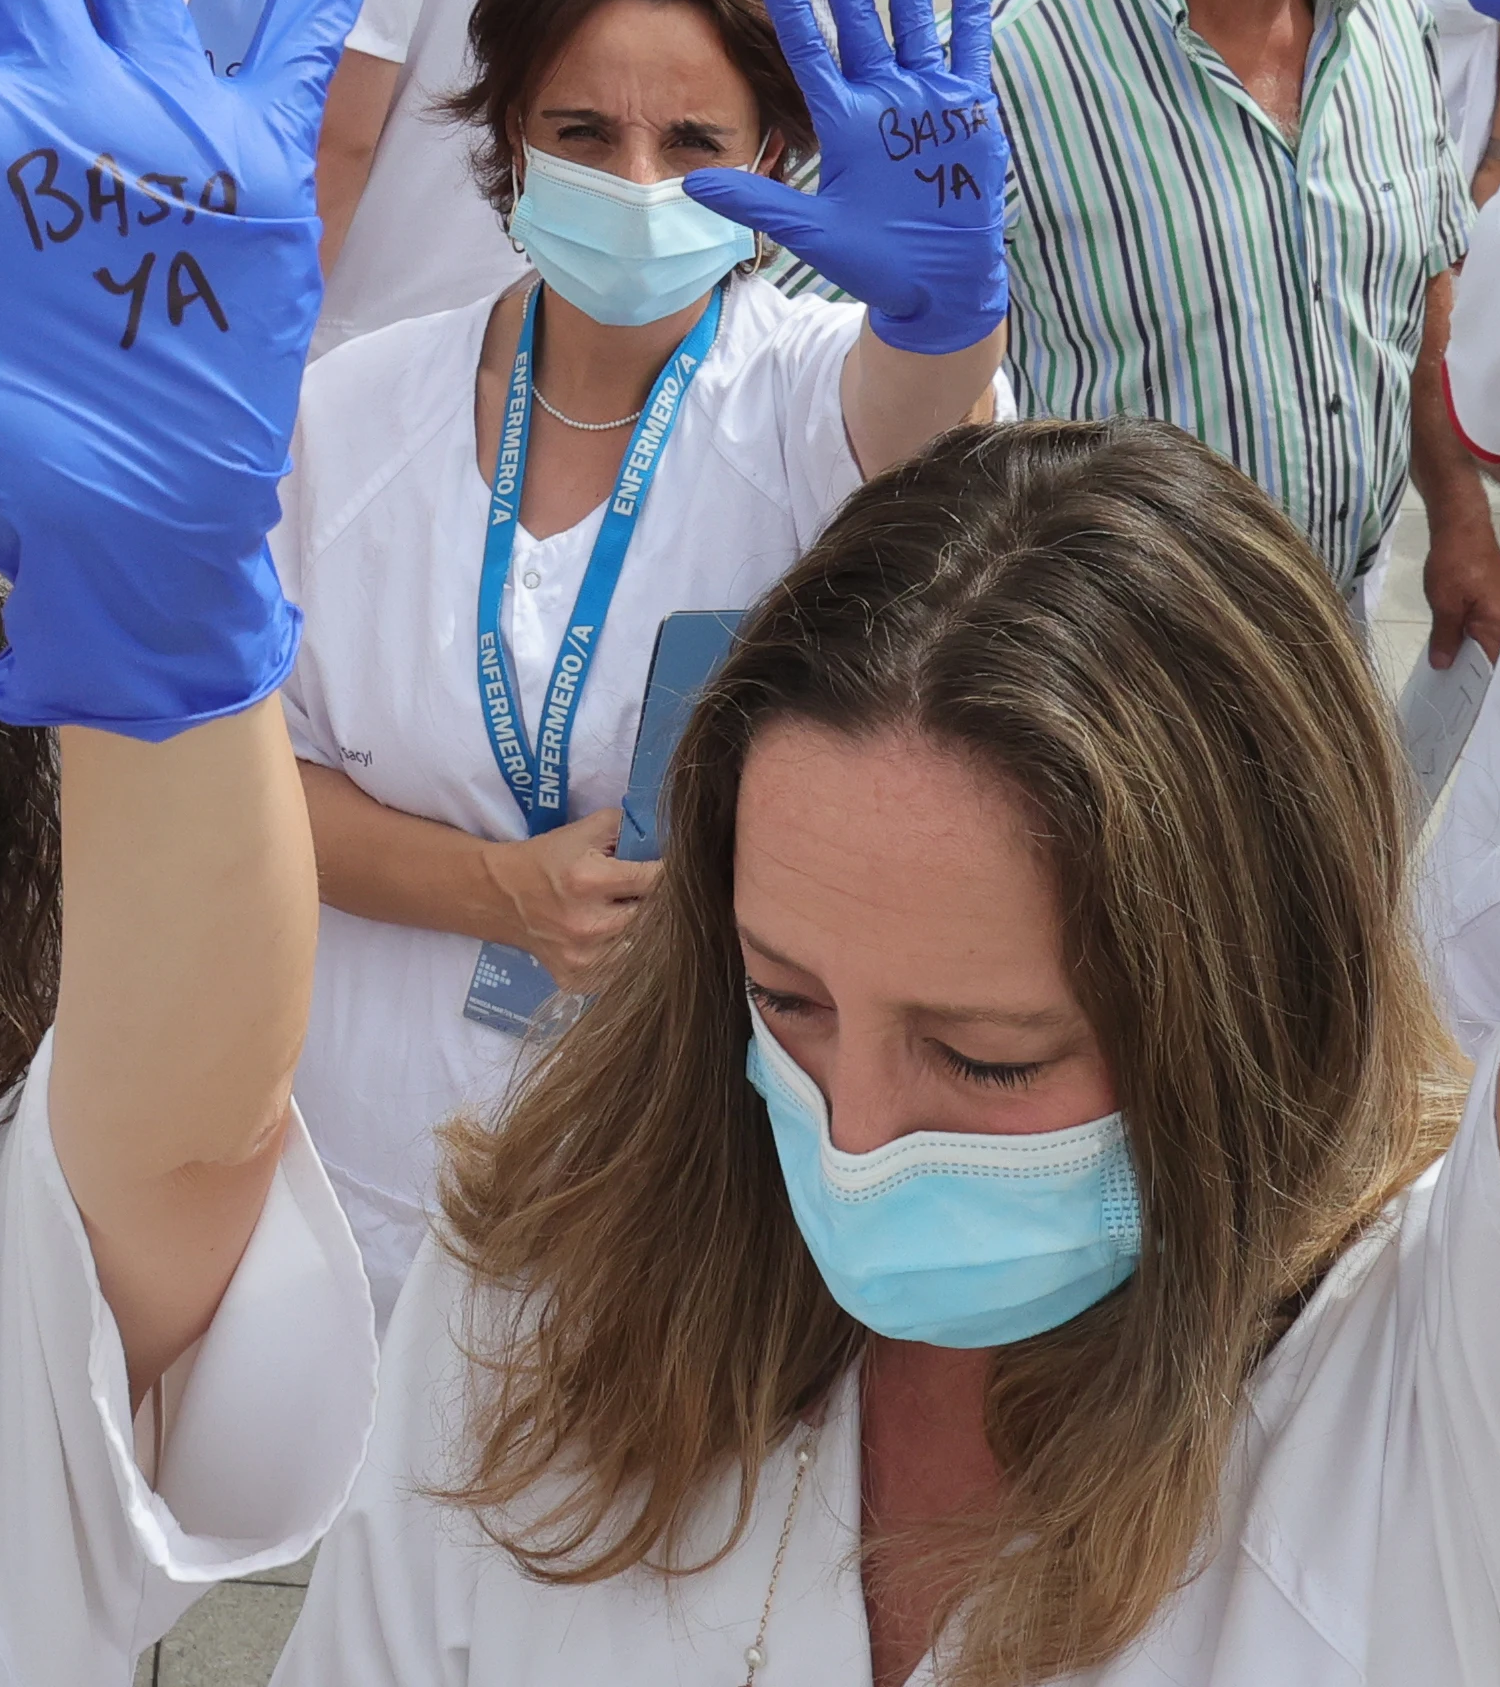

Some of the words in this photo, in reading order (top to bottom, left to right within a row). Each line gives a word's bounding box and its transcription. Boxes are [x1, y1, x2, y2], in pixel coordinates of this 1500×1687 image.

[878, 99, 992, 161] BASTA
[7, 146, 241, 252] BASTA
[914, 162, 982, 209] YA
[92, 250, 231, 351] YA
[492, 351, 529, 526] ENFERMERO/A
[612, 353, 698, 518] ENFERMERO/A
[537, 625, 595, 811] ENFERMERO/A
